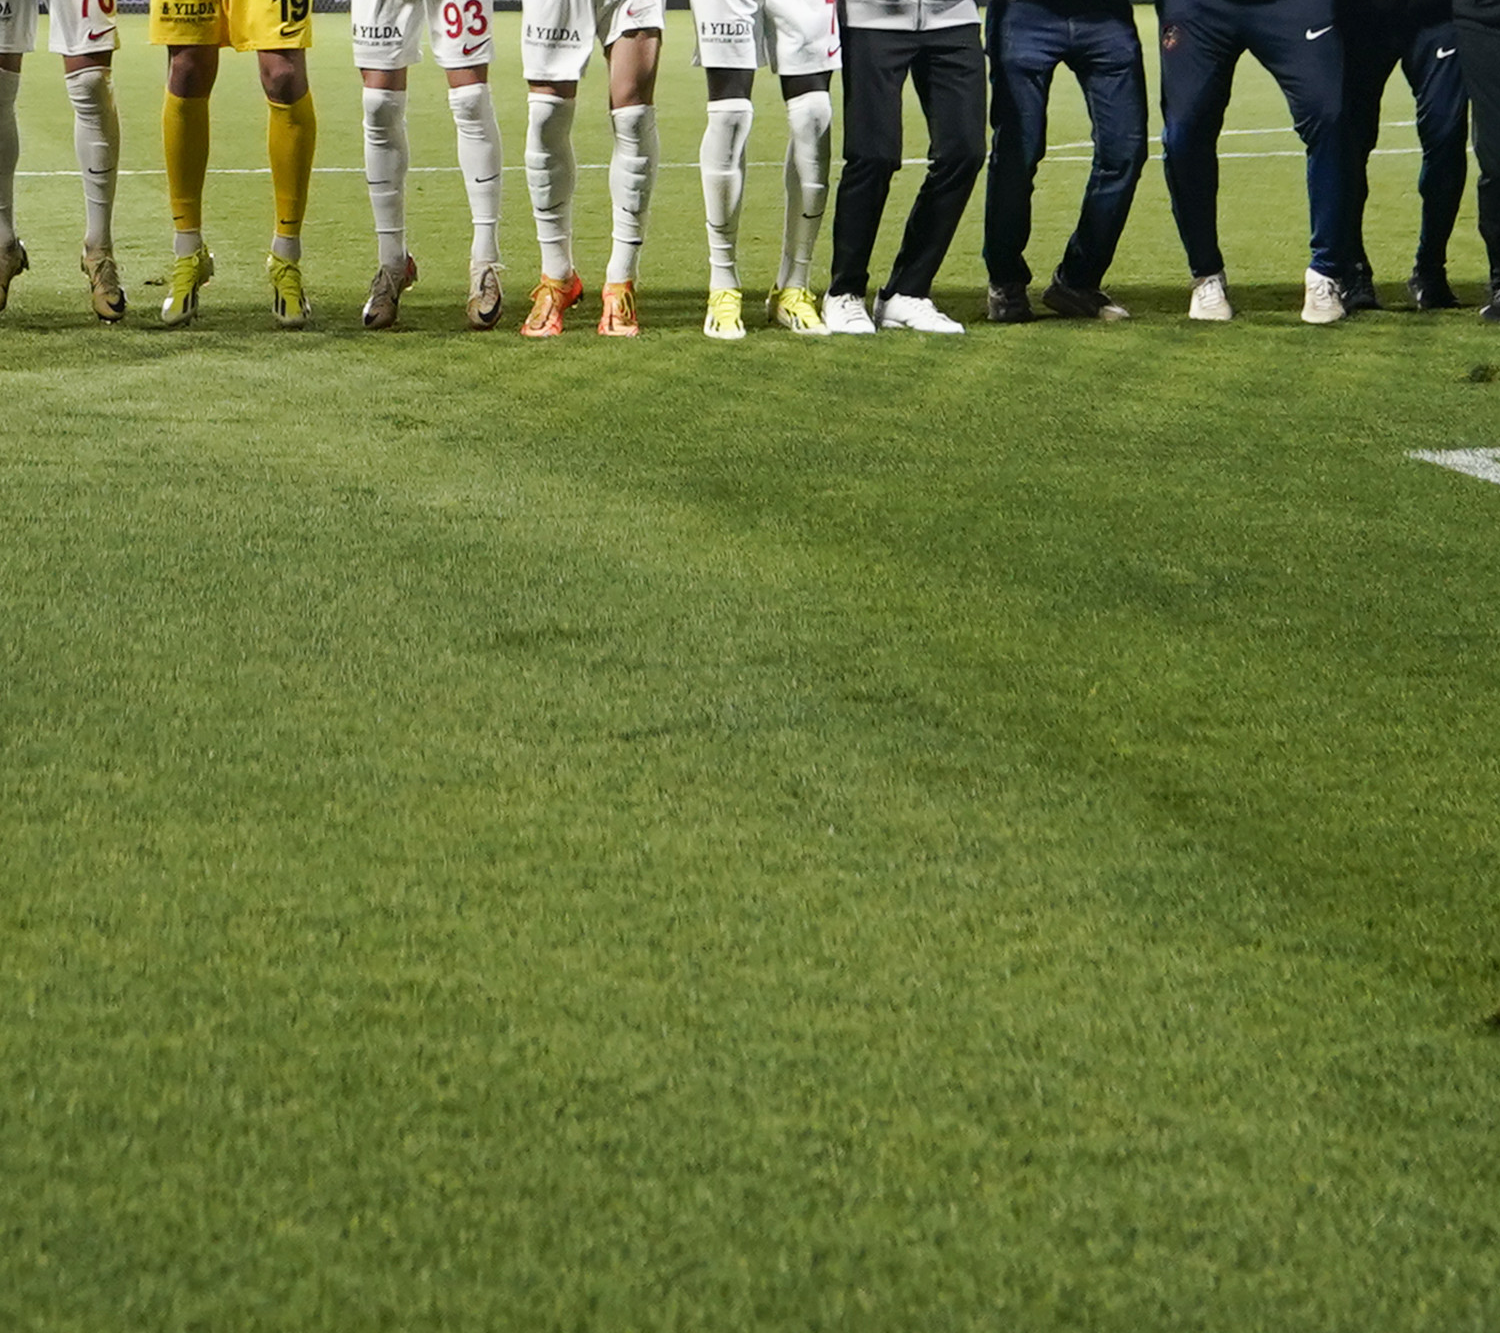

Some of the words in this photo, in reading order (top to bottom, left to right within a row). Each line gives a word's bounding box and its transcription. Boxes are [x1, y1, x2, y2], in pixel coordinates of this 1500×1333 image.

[174, 2, 216, 15] YILDA
[444, 0, 487, 39] 93
[361, 26, 402, 39] YILDA
[536, 27, 582, 41] YILDA
[711, 23, 751, 36] YILDA
